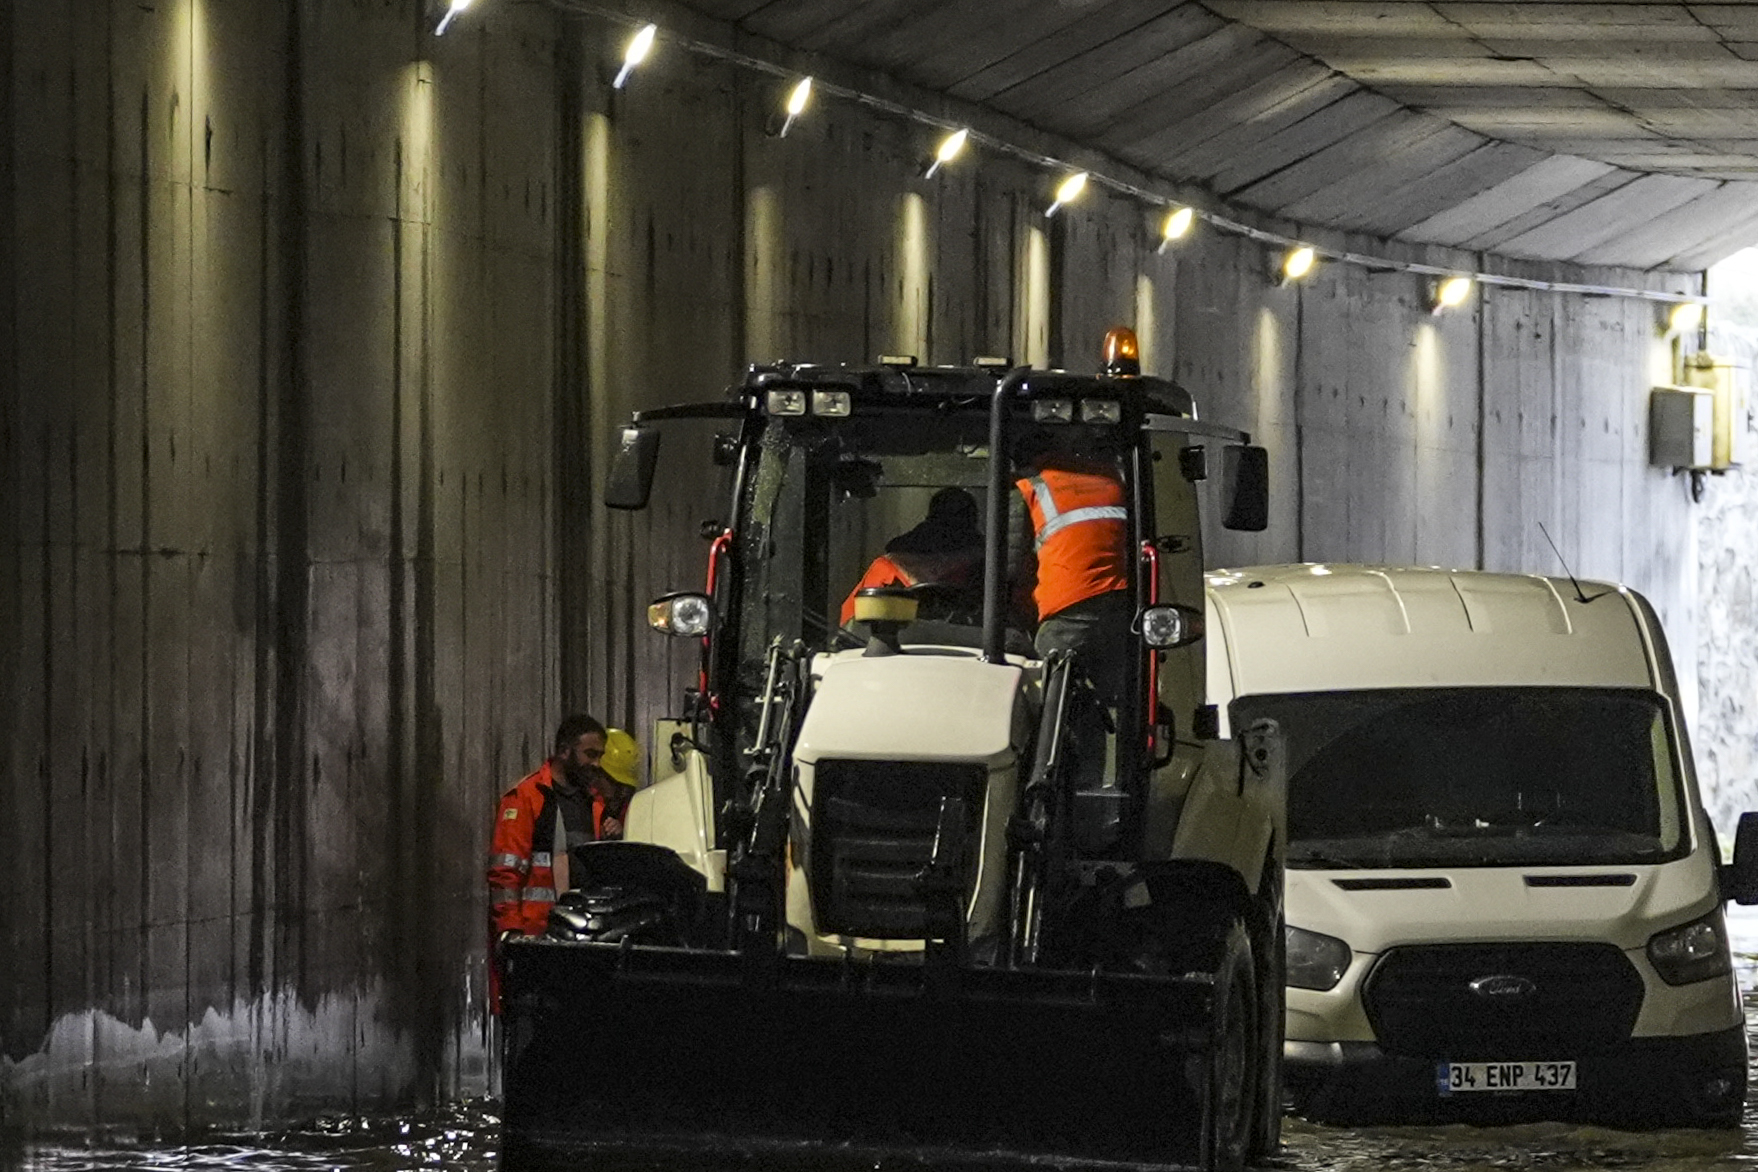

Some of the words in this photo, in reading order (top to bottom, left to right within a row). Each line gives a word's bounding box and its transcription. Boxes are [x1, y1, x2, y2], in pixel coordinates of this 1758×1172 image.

[1451, 1066, 1476, 1088] 34
[1486, 1065, 1524, 1087] ENP
[1534, 1064, 1572, 1086] 437
